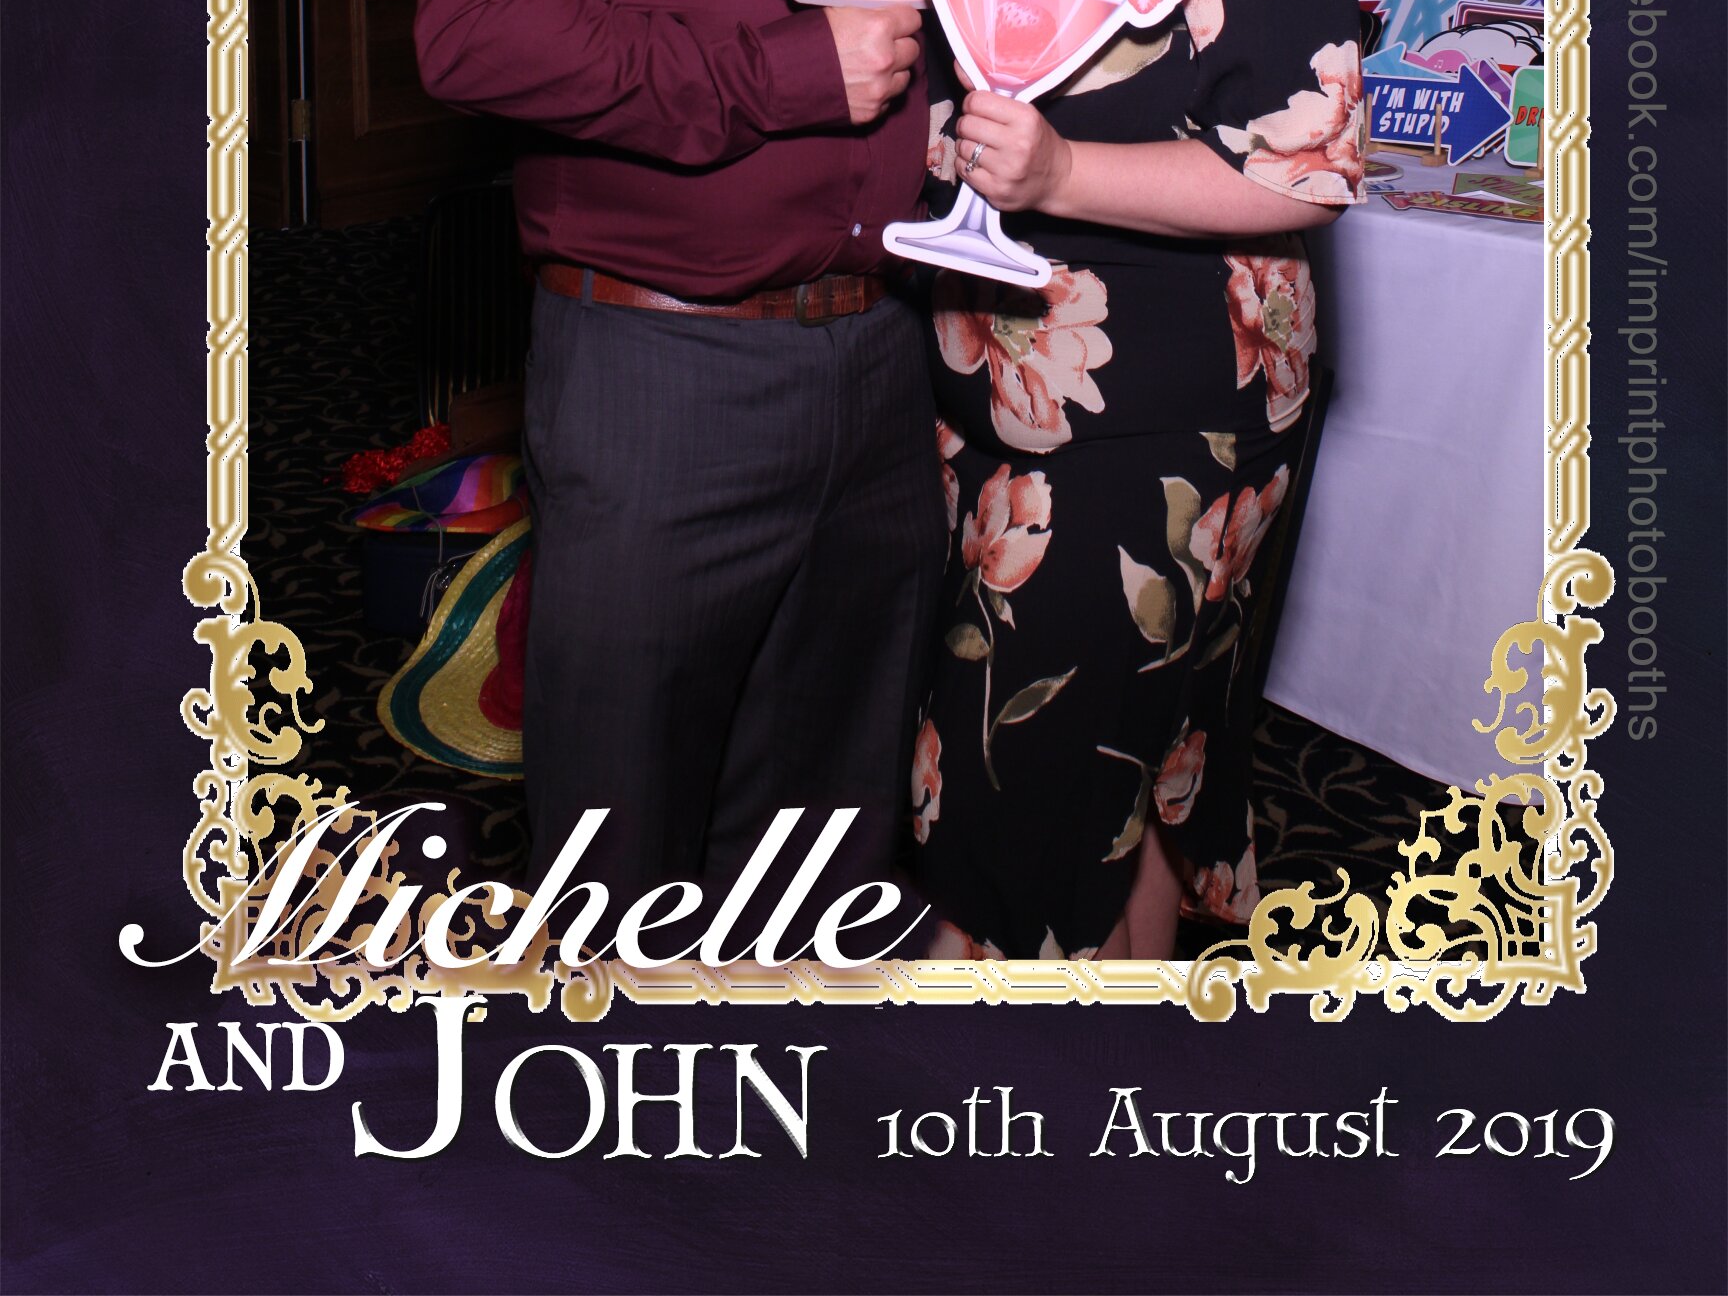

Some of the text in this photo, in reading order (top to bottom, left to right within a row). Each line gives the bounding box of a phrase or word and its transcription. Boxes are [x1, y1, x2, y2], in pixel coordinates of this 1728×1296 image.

[1372, 84, 1465, 113] I'M WITH
[1379, 111, 1450, 135] STUPID
